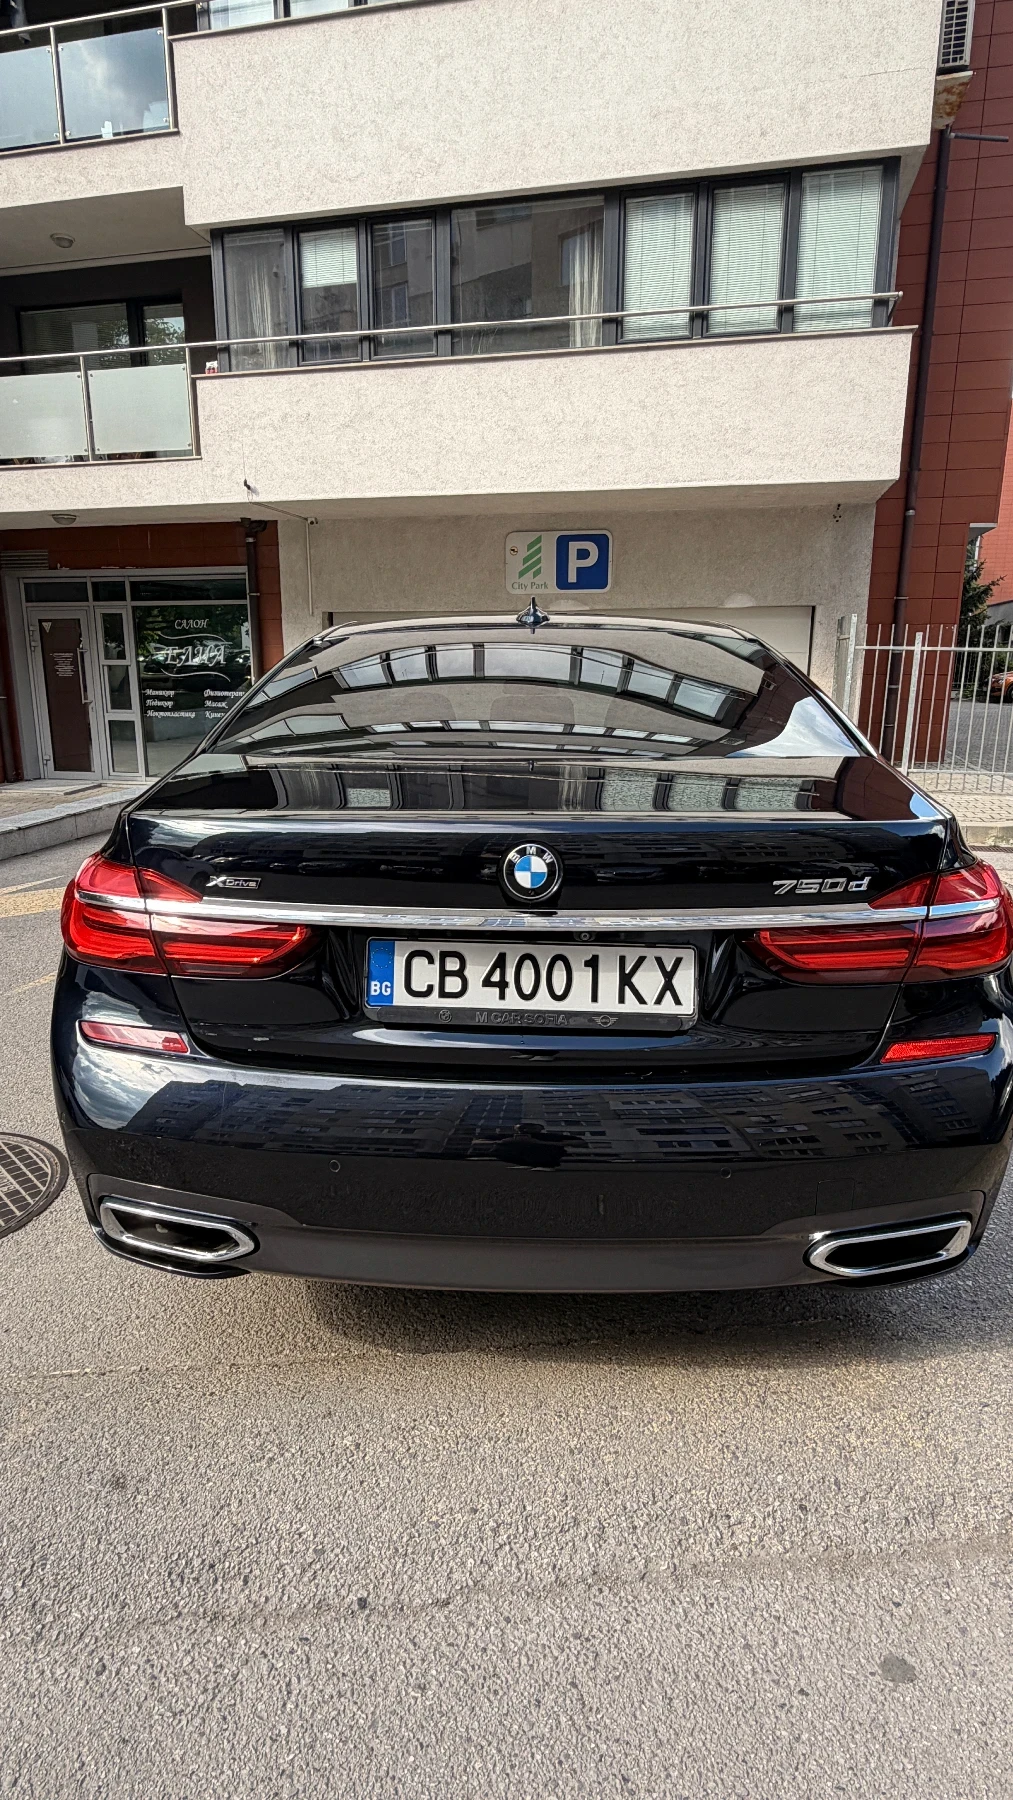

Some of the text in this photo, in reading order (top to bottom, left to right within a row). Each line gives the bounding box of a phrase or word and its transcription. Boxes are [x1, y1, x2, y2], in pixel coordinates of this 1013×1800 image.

[567, 541, 599, 583] P
[511, 582, 549, 591] City Park
[174, 618, 210, 630] САЛОН
[145, 688, 175, 698] Маникюр
[145, 699, 174, 709] Педикюр
[509, 845, 554, 864] BMW
[772, 876, 872, 895] 750d
[480, 951, 600, 1004] 4001
[370, 981, 391, 996] BG
[475, 1011, 569, 1026] M CAR SOFIA
